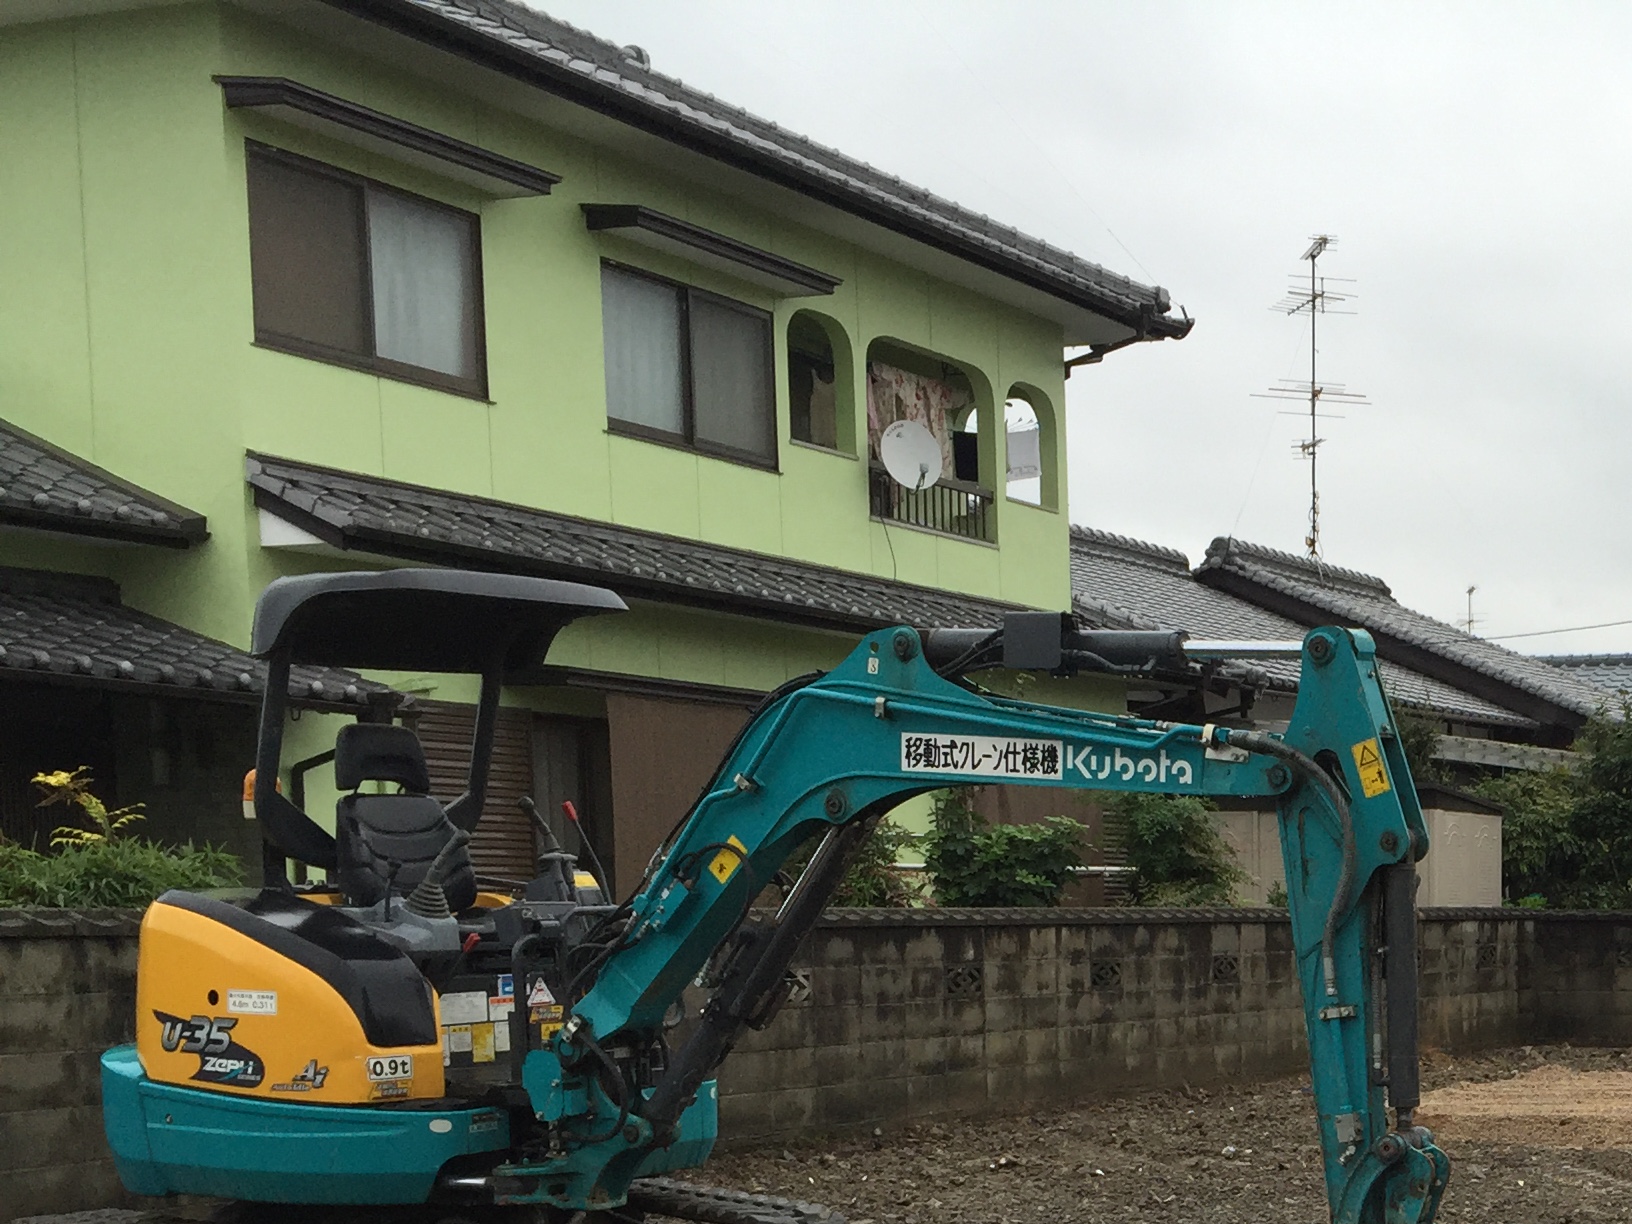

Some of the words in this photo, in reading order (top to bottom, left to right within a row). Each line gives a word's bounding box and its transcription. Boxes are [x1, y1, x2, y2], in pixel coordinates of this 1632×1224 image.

[905, 736, 1059, 775] 移動式クレーン仕様機
[1066, 744, 1193, 784] Kubota
[162, 1015, 237, 1052] U-35
[373, 1059, 409, 1077] 0.9t
